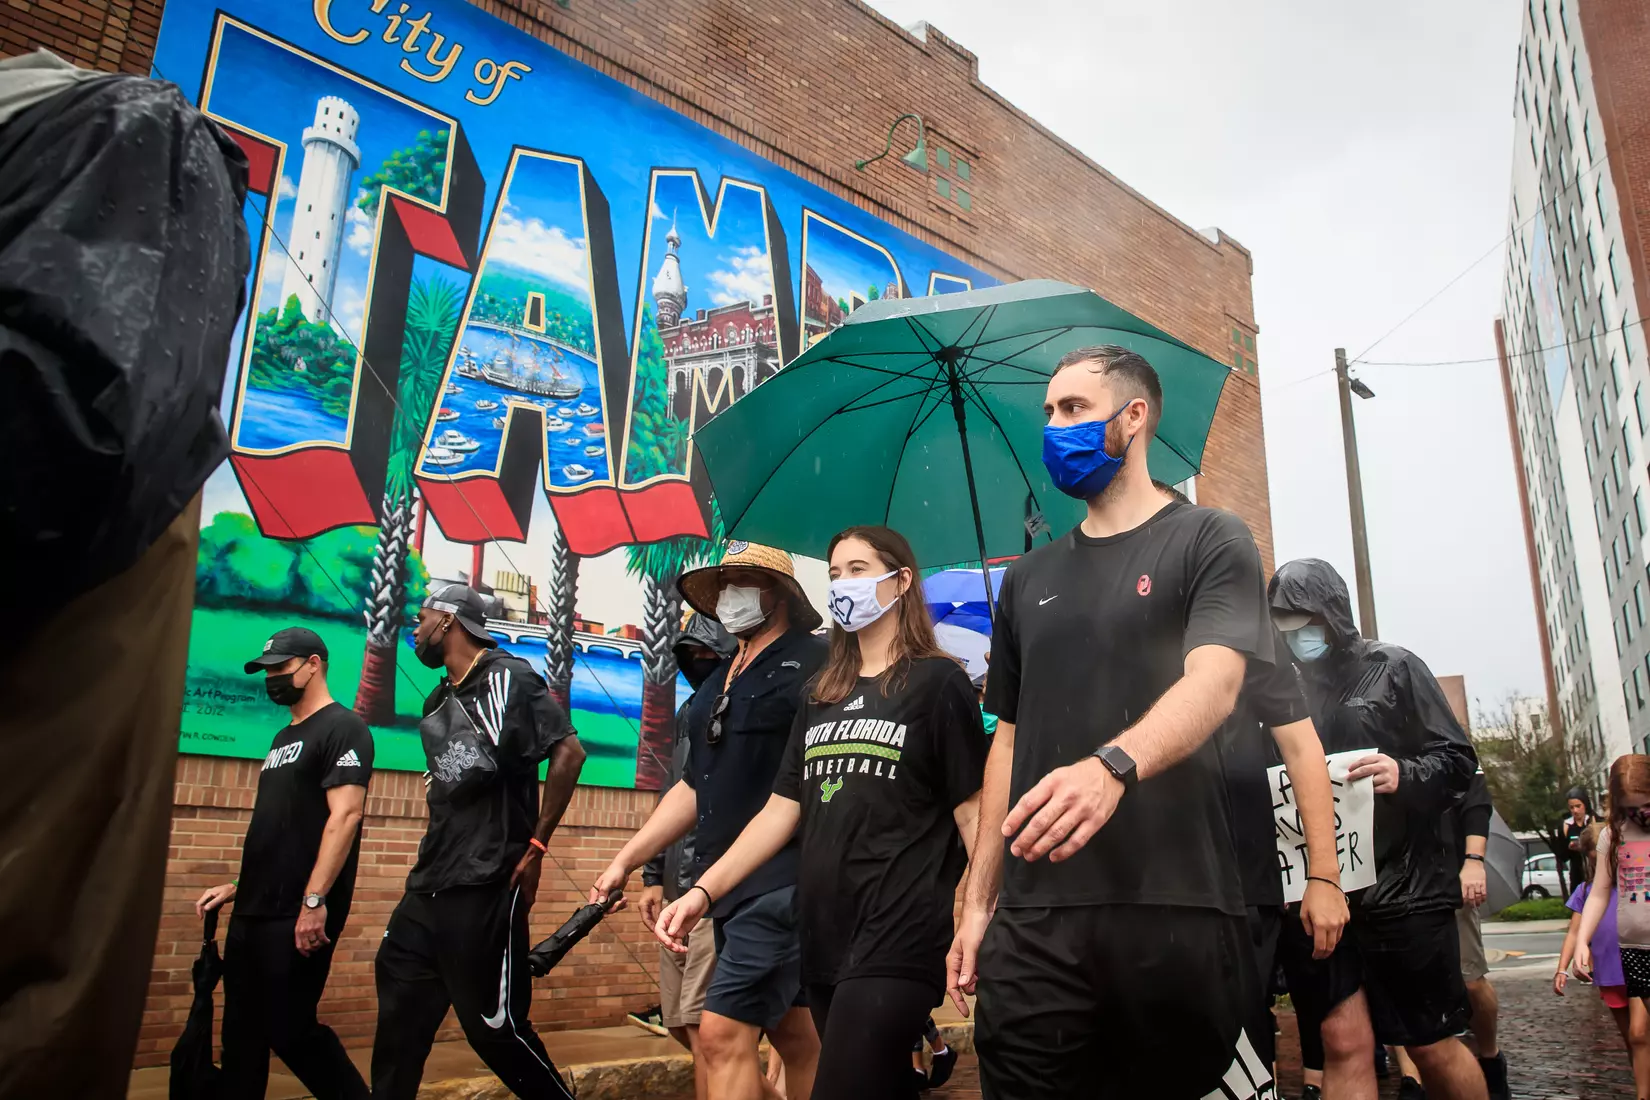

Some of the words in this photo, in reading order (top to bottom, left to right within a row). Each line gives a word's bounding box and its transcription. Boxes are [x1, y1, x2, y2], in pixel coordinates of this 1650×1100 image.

[313, 0, 464, 83] City
[464, 58, 533, 107] of
[196, 704, 226, 716] 2012
[833, 718, 908, 748] FLORIDA
